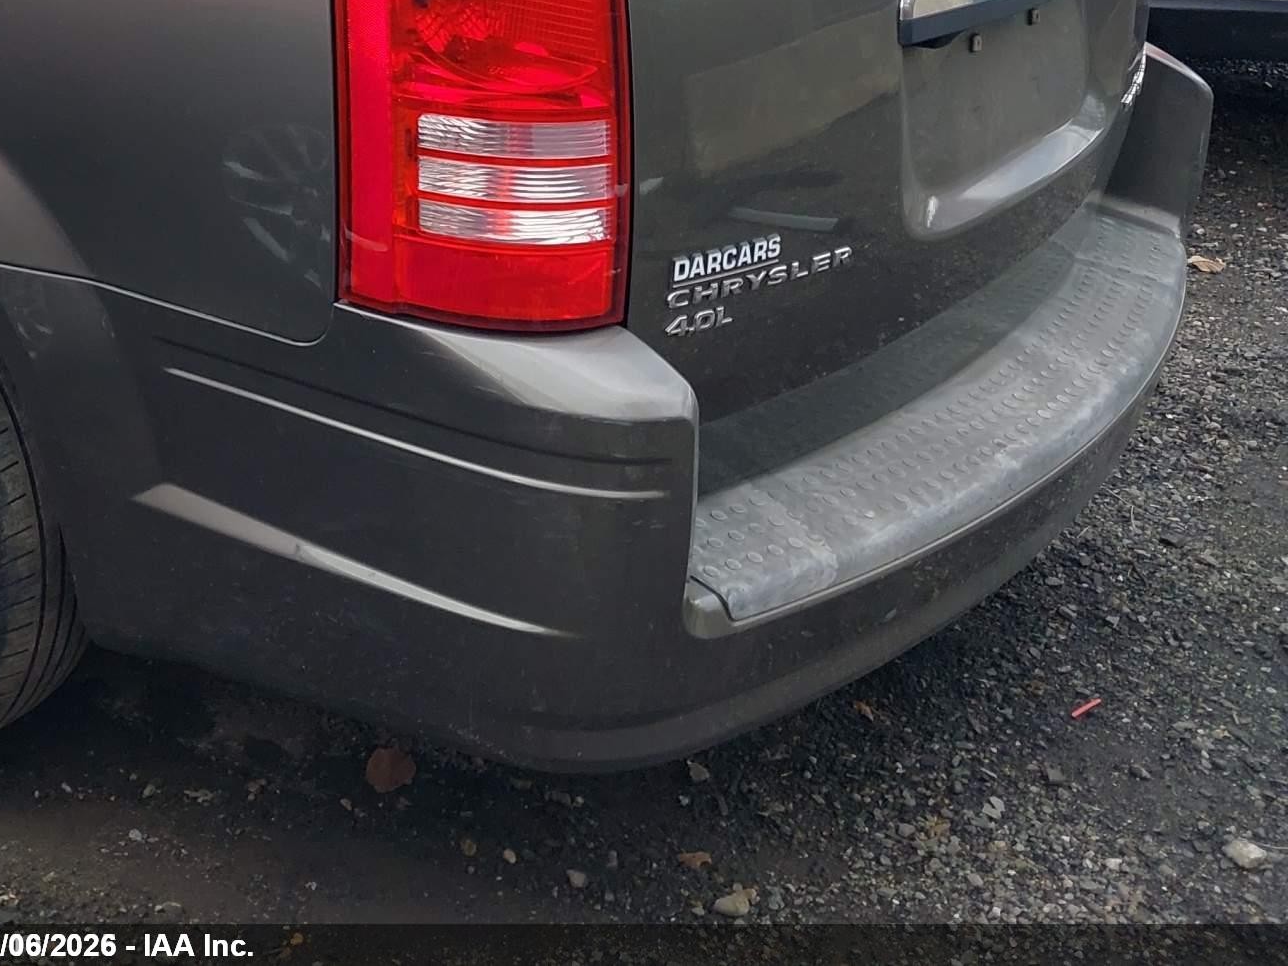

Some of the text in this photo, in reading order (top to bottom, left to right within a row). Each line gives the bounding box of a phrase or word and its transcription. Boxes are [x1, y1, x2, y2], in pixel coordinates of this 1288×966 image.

[666, 246, 853, 309] CHRYSLER
[672, 233, 781, 282] DARCARS
[664, 305, 733, 336] 4.0L
